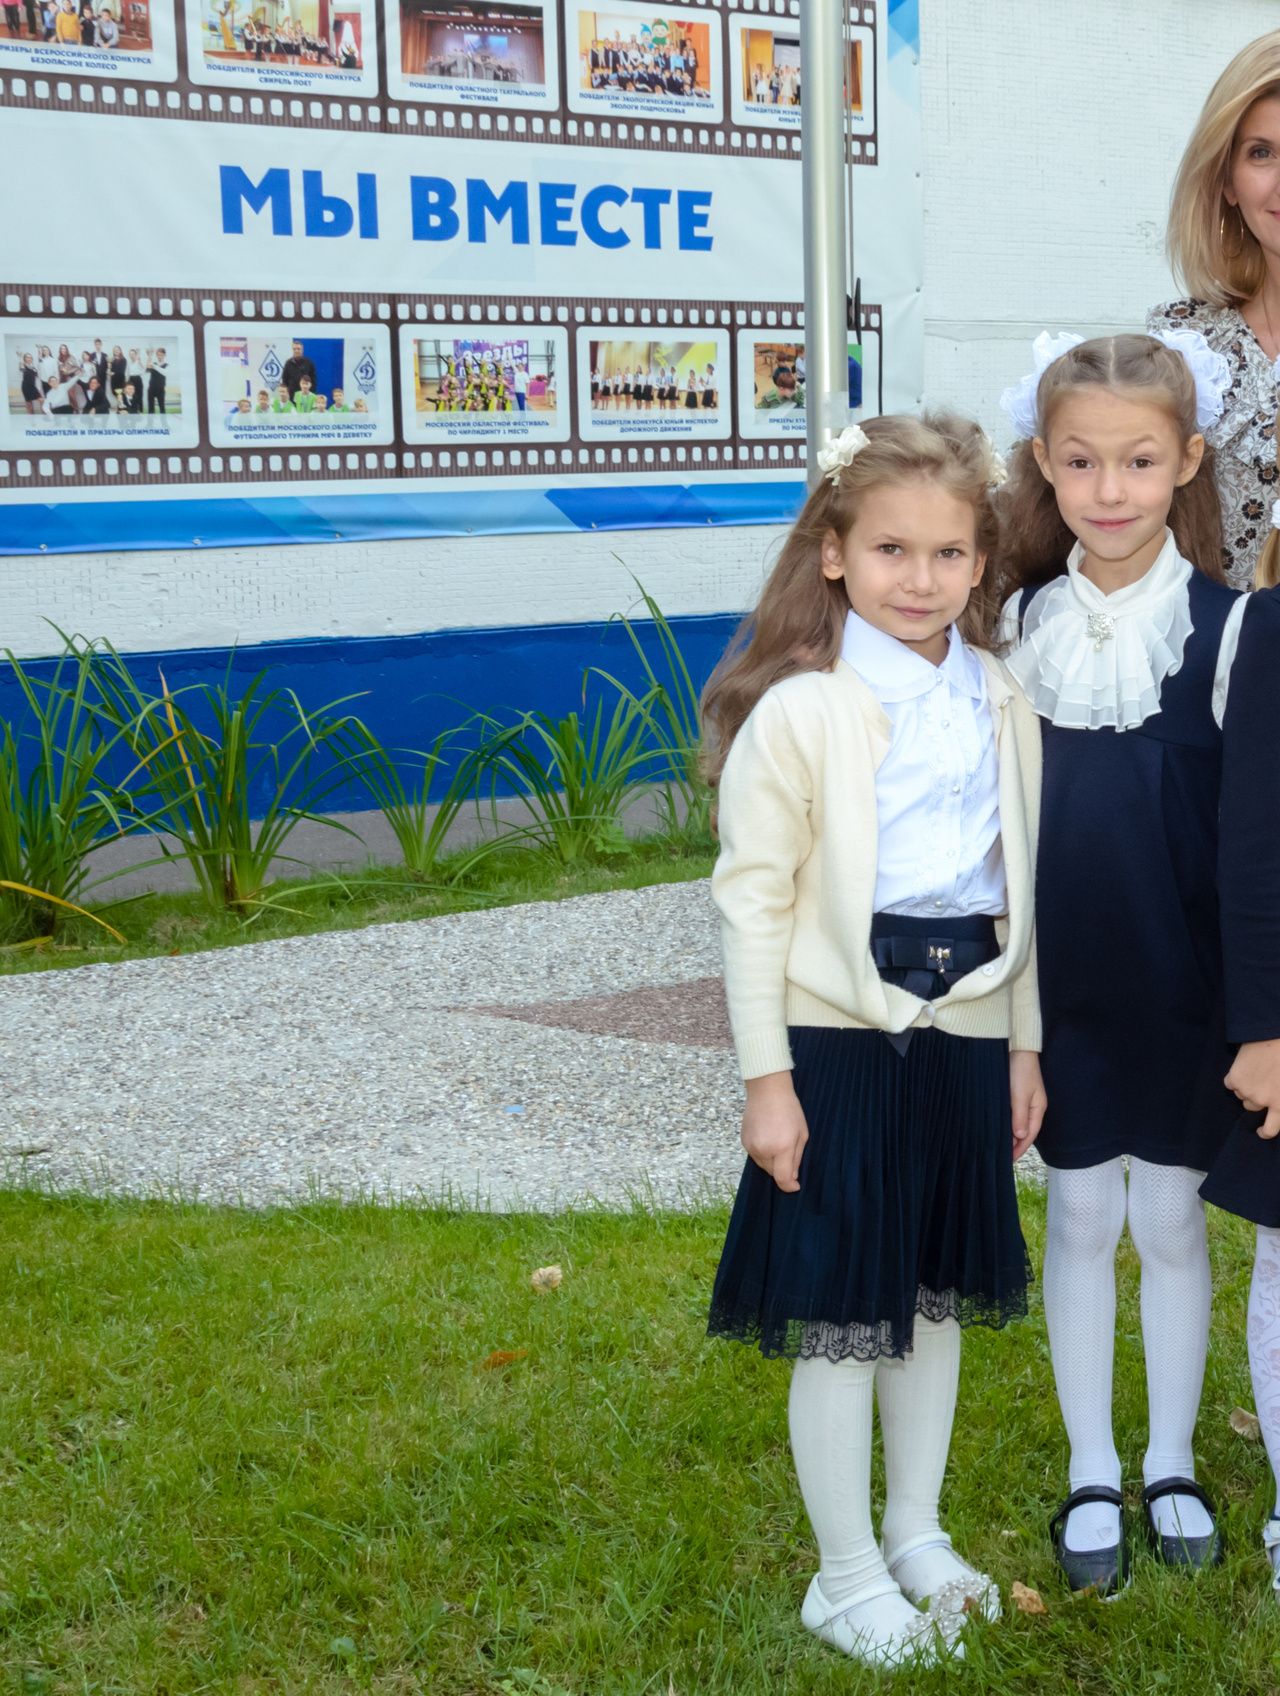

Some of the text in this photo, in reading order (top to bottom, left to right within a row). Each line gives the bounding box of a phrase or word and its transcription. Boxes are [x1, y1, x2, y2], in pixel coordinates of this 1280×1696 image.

[34, 47, 108, 60] ВСЕРОССИЙСКОГО
[110, 55, 152, 64] КОНКУРСА
[30, 56, 118, 70] БЕЗОПАСНОЕ КОЛЕСО
[206, 64, 362, 82] ПОБЕДИТЕЛИ ВСЕРОССИЙСКОГО КОНКУРСА
[259, 76, 292, 85] СВИРЕЛЬ
[409, 81, 546, 98] ПОБЕДИТЕЛИ ОБЛАСТНОГО ТЕАТРАЛЬНОГО
[460, 94, 498, 102] ФЕСТИВАЛЯ
[579, 92, 619, 101] ПОБЕДИТЕЛИ
[622, 96, 674, 105] ЭКОЛОГИЧЕСКОЙ
[745, 106, 781, 115] ПОБЕДИТЕЛИ
[219, 165, 714, 251] МЫ ВМЕСТЕ
[425, 420, 470, 428] МОСКОВСКИЙ
